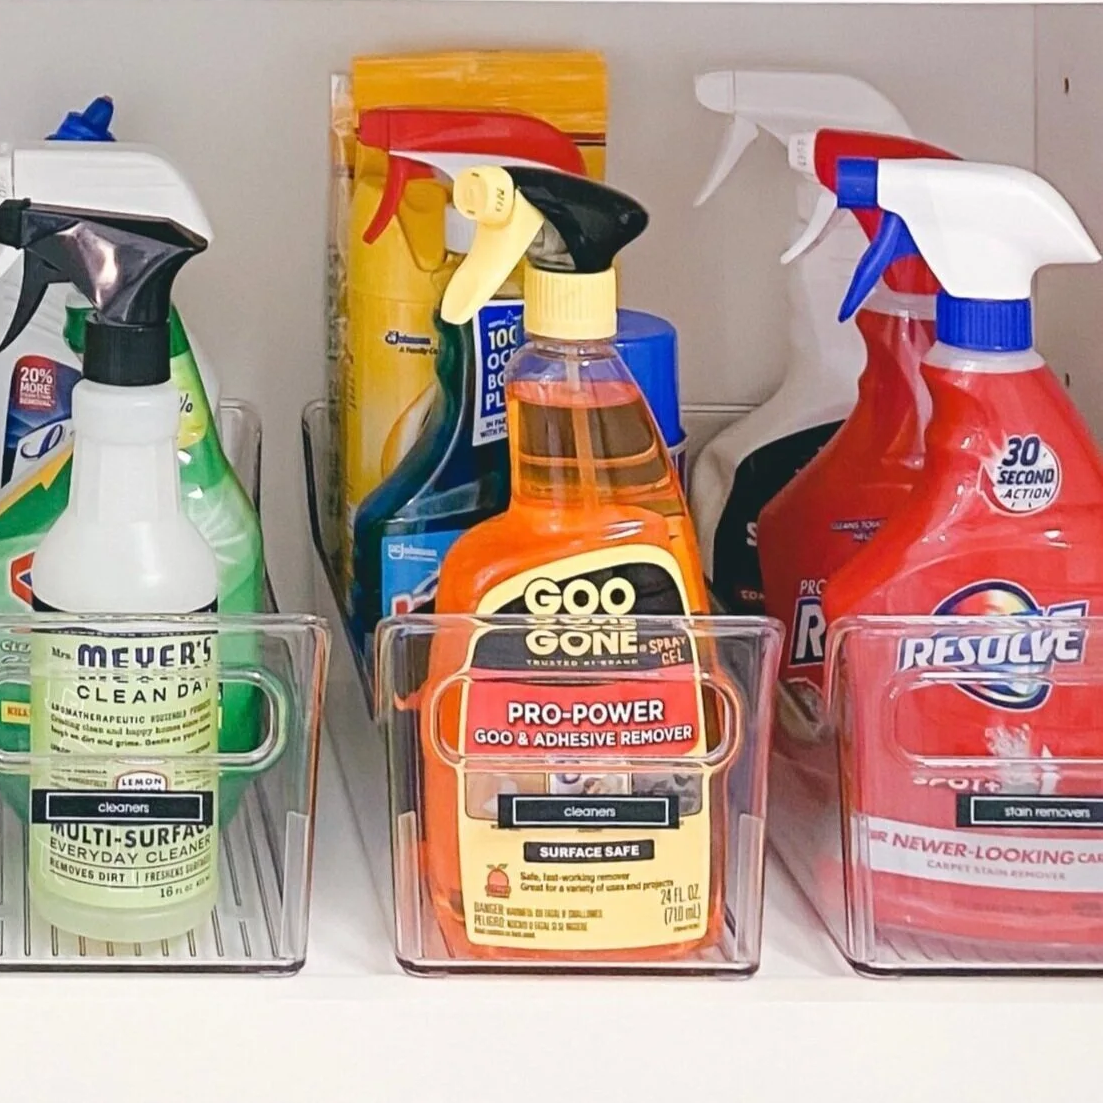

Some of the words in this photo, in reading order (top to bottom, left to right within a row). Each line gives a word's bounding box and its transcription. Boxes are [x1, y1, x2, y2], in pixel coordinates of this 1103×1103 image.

[20, 366, 53, 384] 20%
[19, 382, 51, 394] MORE
[1002, 436, 1040, 467] 30
[997, 468, 1055, 485] SECOND
[1003, 487, 1052, 499] ACTION
[524, 576, 637, 617] GOO
[525, 628, 638, 657] GONE
[648, 635, 687, 655] SPRAY
[900, 625, 1081, 672] RESOLVE
[51, 646, 74, 661] Mrs.
[77, 637, 212, 669] MEYER'S
[661, 648, 685, 666] GEL
[77, 684, 167, 705] CLEAN
[51, 702, 146, 724] AROMATHERAPEUTIC
[507, 699, 665, 726] PRO-POWER
[82, 722, 105, 734] clean
[106, 725, 123, 735] and
[125, 724, 153, 737] happy
[474, 728, 514, 746] GOO
[517, 730, 529, 746] &
[533, 730, 616, 747] ADHESIVE
[620, 725, 694, 746] REMOVER
[81, 734, 95, 744] dirt
[97, 738, 113, 747] and
[122, 777, 162, 787] LEMON
[98, 801, 150, 815] cleaners
[564, 804, 616, 818] cleaners
[1004, 805, 1033, 817] stain
[1035, 806, 1091, 819] removers
[50, 836, 138, 864] EVERYDAY
[146, 834, 211, 863] CLEANER
[539, 845, 603, 859] SURFACE
[605, 844, 640, 858] SAFE
[892, 832, 1075, 865] NEWER-LOOKING
[50, 857, 95, 880] REMOVES
[98, 870, 126, 883] DIRT
[145, 865, 184, 882] FRESHENS
[520, 871, 542, 883] Safe,
[543, 871, 596, 884] fast-working
[597, 871, 631, 881] remover
[927, 860, 970, 874] CARPET
[974, 865, 1008, 877] STAIN
[1010, 869, 1066, 880] REMOVER
[160, 885, 174, 899] 16
[520, 882, 544, 893] Great
[546, 882, 557, 893] for
[566, 882, 595, 895] variety
[596, 882, 605, 893] of
[606, 883, 625, 893] uses
[627, 881, 642, 891] and
[643, 878, 674, 892] projects
[660, 888, 672, 906] 24
